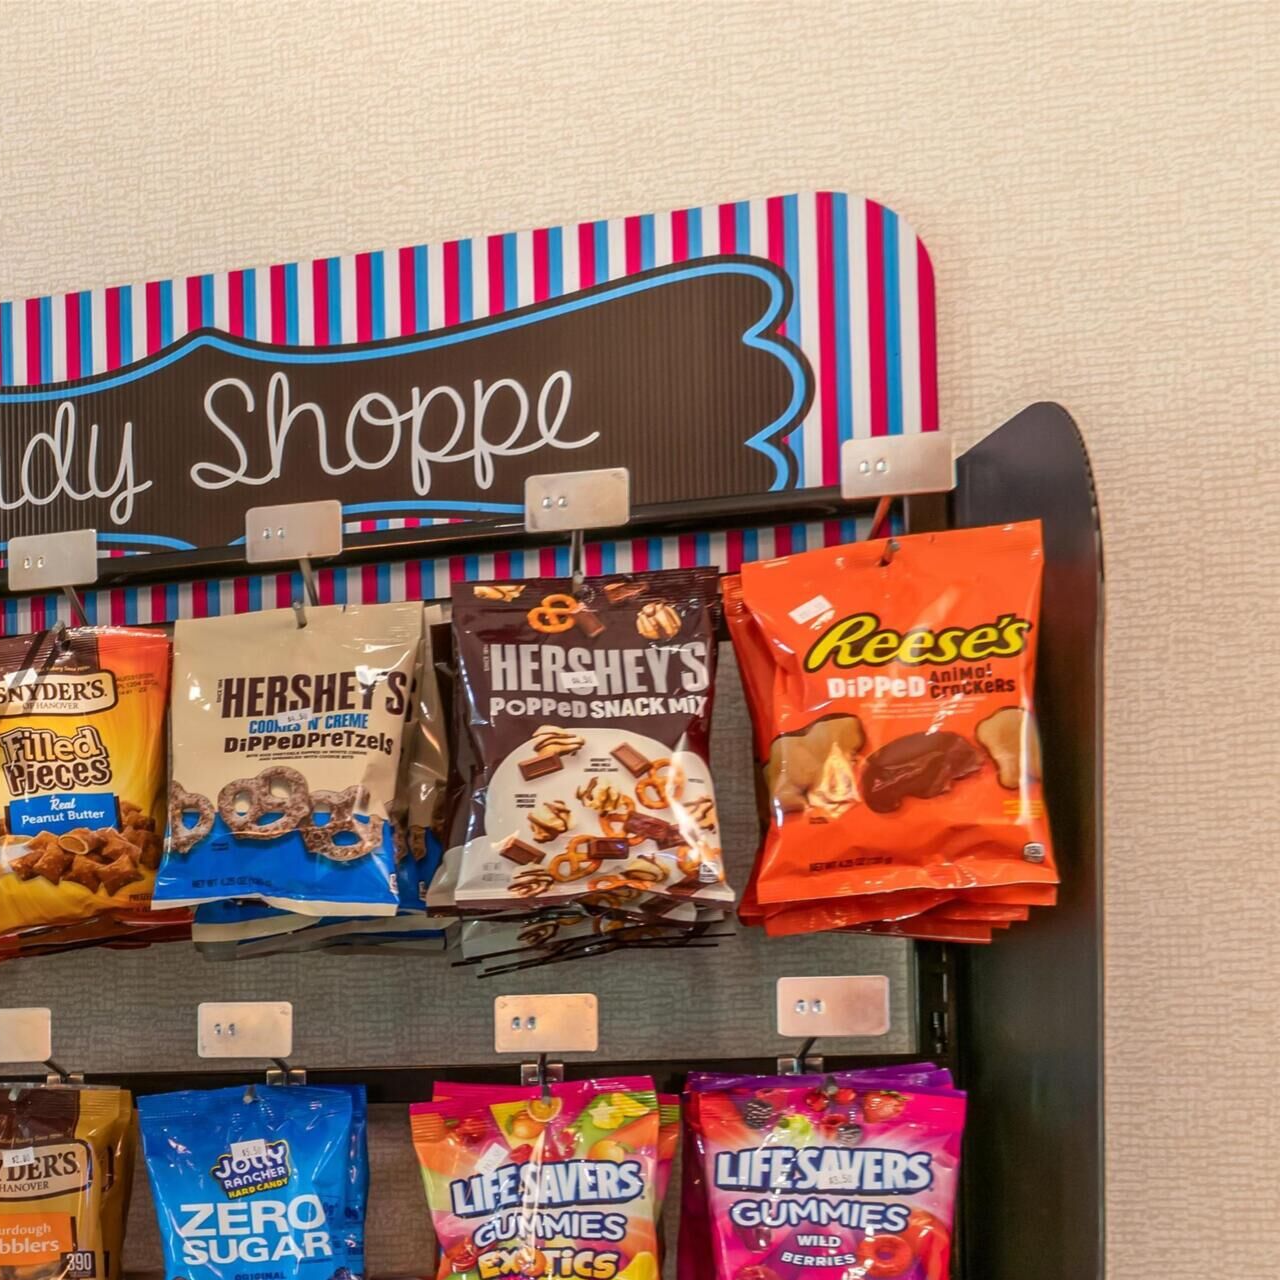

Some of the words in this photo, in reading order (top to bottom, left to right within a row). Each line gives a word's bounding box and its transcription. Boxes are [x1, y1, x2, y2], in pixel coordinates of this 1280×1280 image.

[191, 369, 600, 516] Shoppe
[489, 642, 707, 693] HERSHEY'S
[222, 670, 408, 718] HERSHEY'S
[324, 714, 368, 731] CREME
[51, 796, 75, 811] Real
[21, 811, 63, 824] Peanut
[66, 808, 104, 821] Butter
[224, 1167, 286, 1188] RANCHER
[228, 1185, 256, 1198] HARD
[258, 1177, 289, 1192] CANDY
[180, 1196, 326, 1238] ZERO
[732, 1199, 911, 1231] GUMMIES
[474, 1214, 627, 1245] GUMMIES
[183, 1232, 332, 1266] SUGAR
[798, 1235, 841, 1247] WILD
[66, 1252, 92, 1272] 390
[781, 1252, 856, 1266] BERRIES
